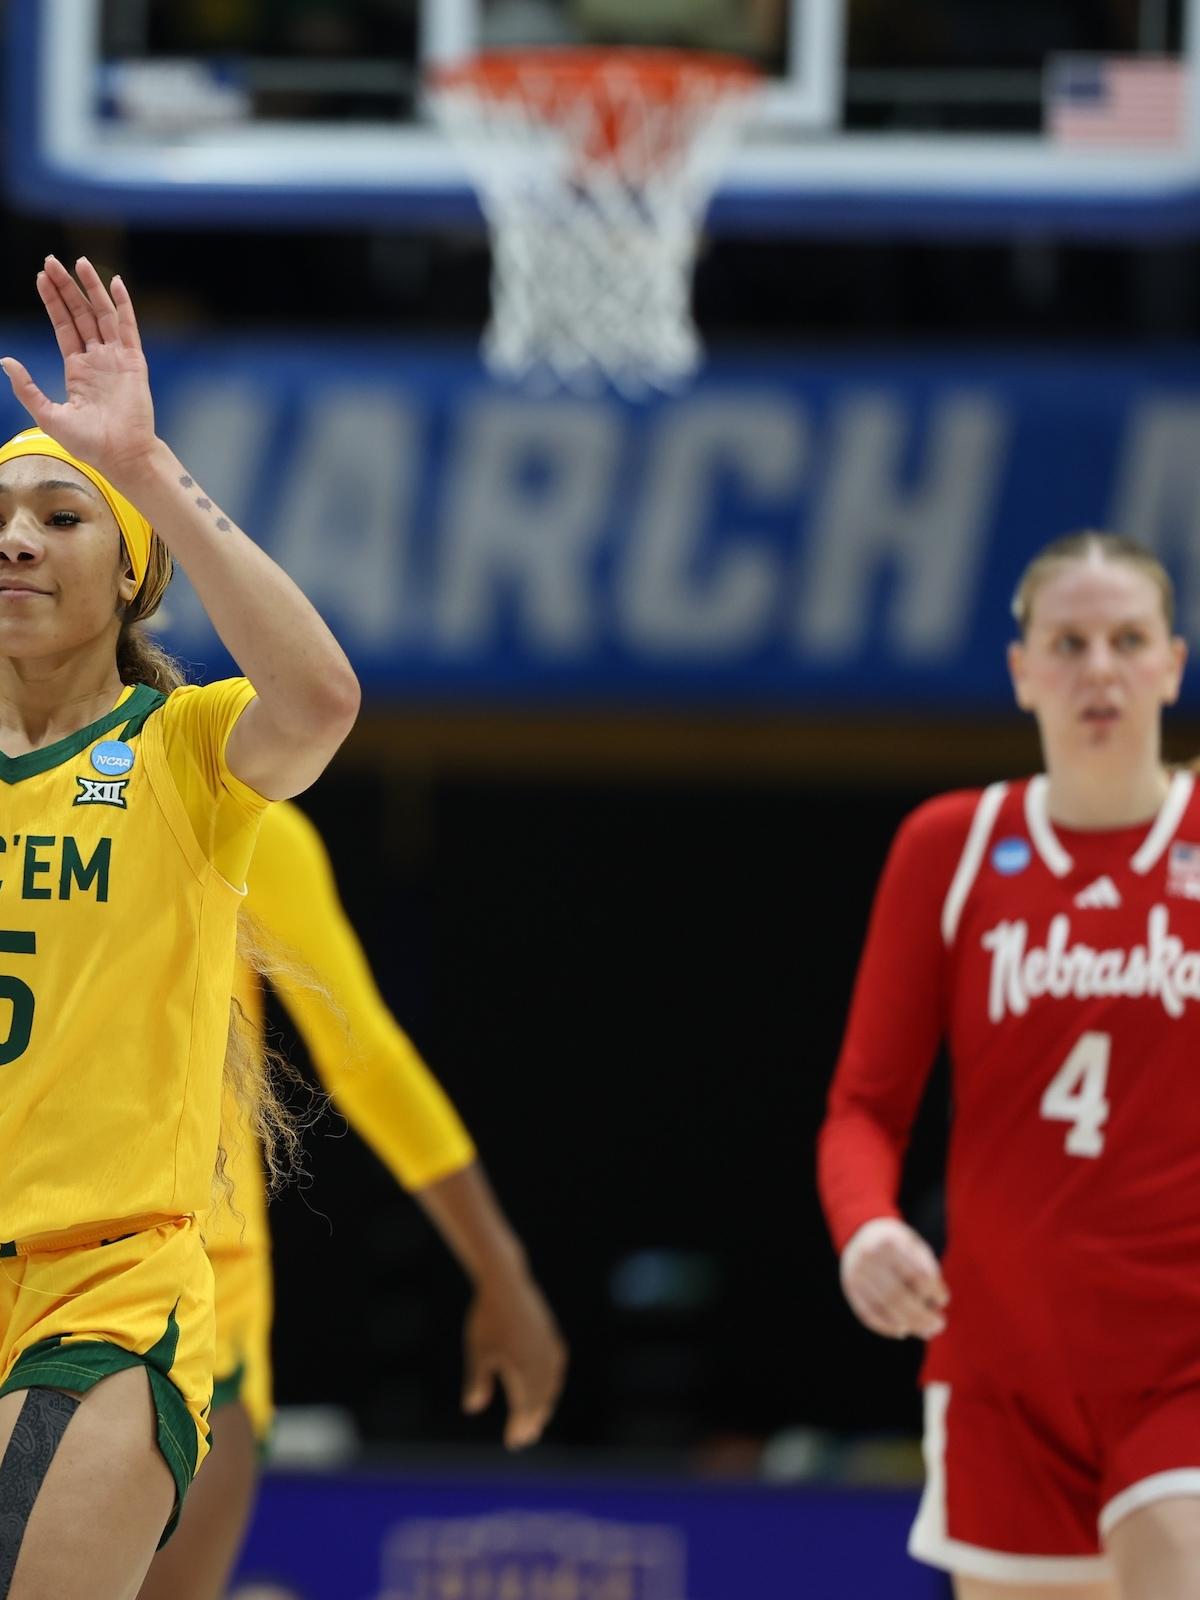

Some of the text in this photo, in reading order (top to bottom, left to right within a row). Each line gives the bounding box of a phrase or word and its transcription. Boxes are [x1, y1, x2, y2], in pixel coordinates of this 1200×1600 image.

[75, 777, 128, 807] XII
[96, 755, 132, 768] NCAA
[981, 903, 1200, 1023] Nebraska
[1040, 1030, 1111, 1158] 4
